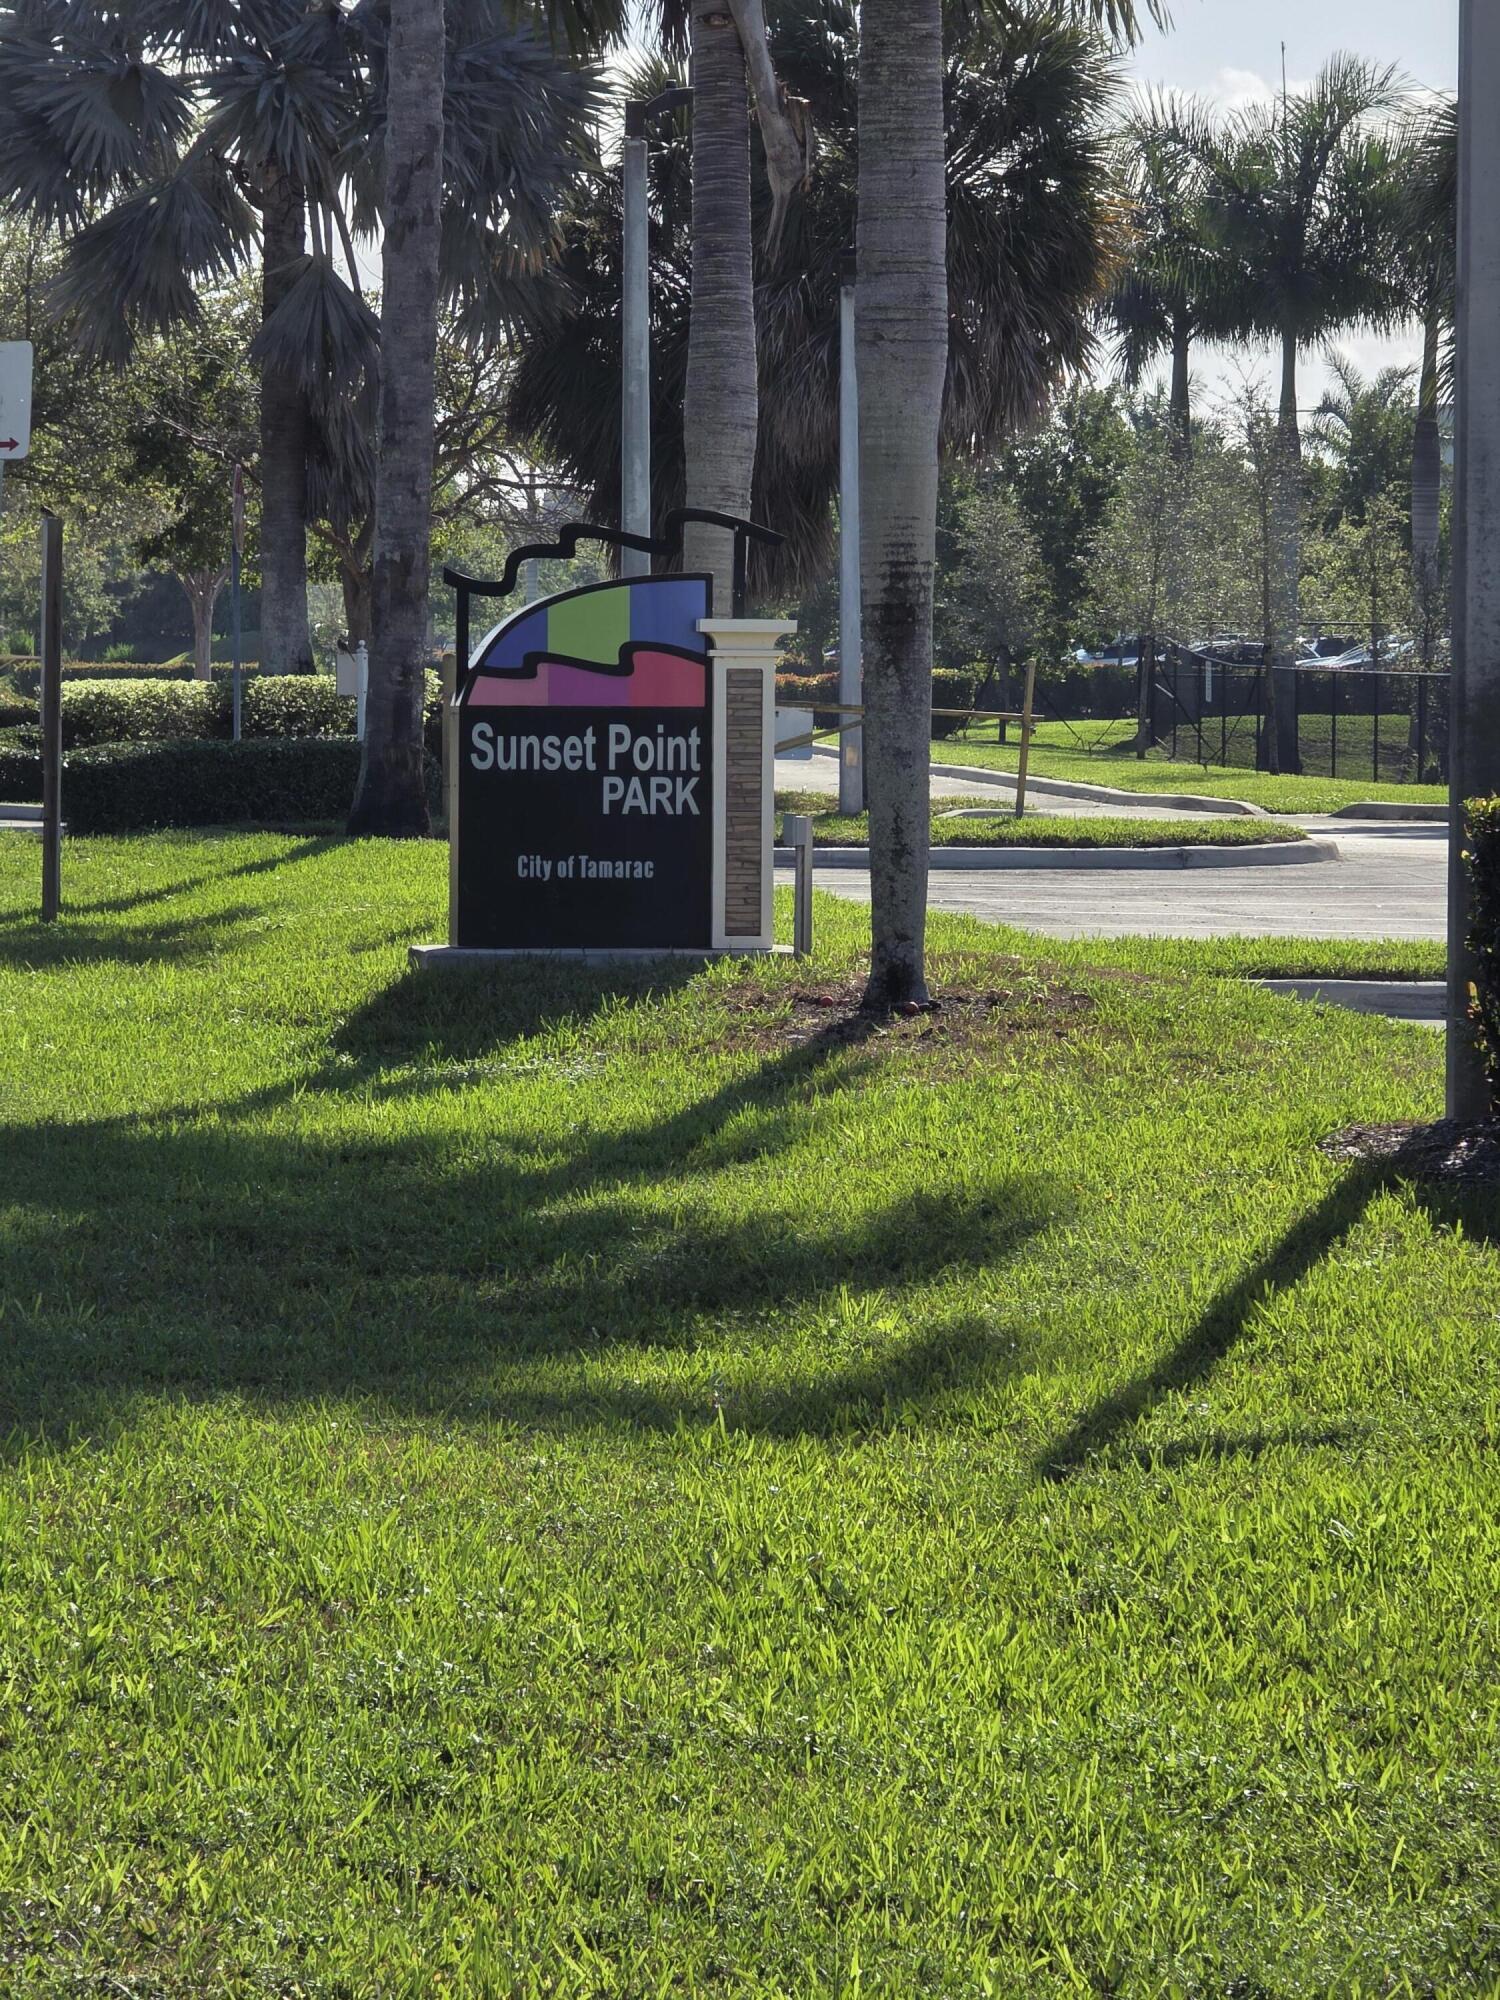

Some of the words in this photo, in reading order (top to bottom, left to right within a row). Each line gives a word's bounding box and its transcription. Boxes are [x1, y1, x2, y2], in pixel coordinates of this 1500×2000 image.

[470, 722, 597, 771] Sunset
[608, 723, 701, 772] Point
[602, 776, 701, 815] PARK
[517, 855, 552, 881] City
[557, 855, 575, 878] of
[579, 855, 654, 878] Tamarac
